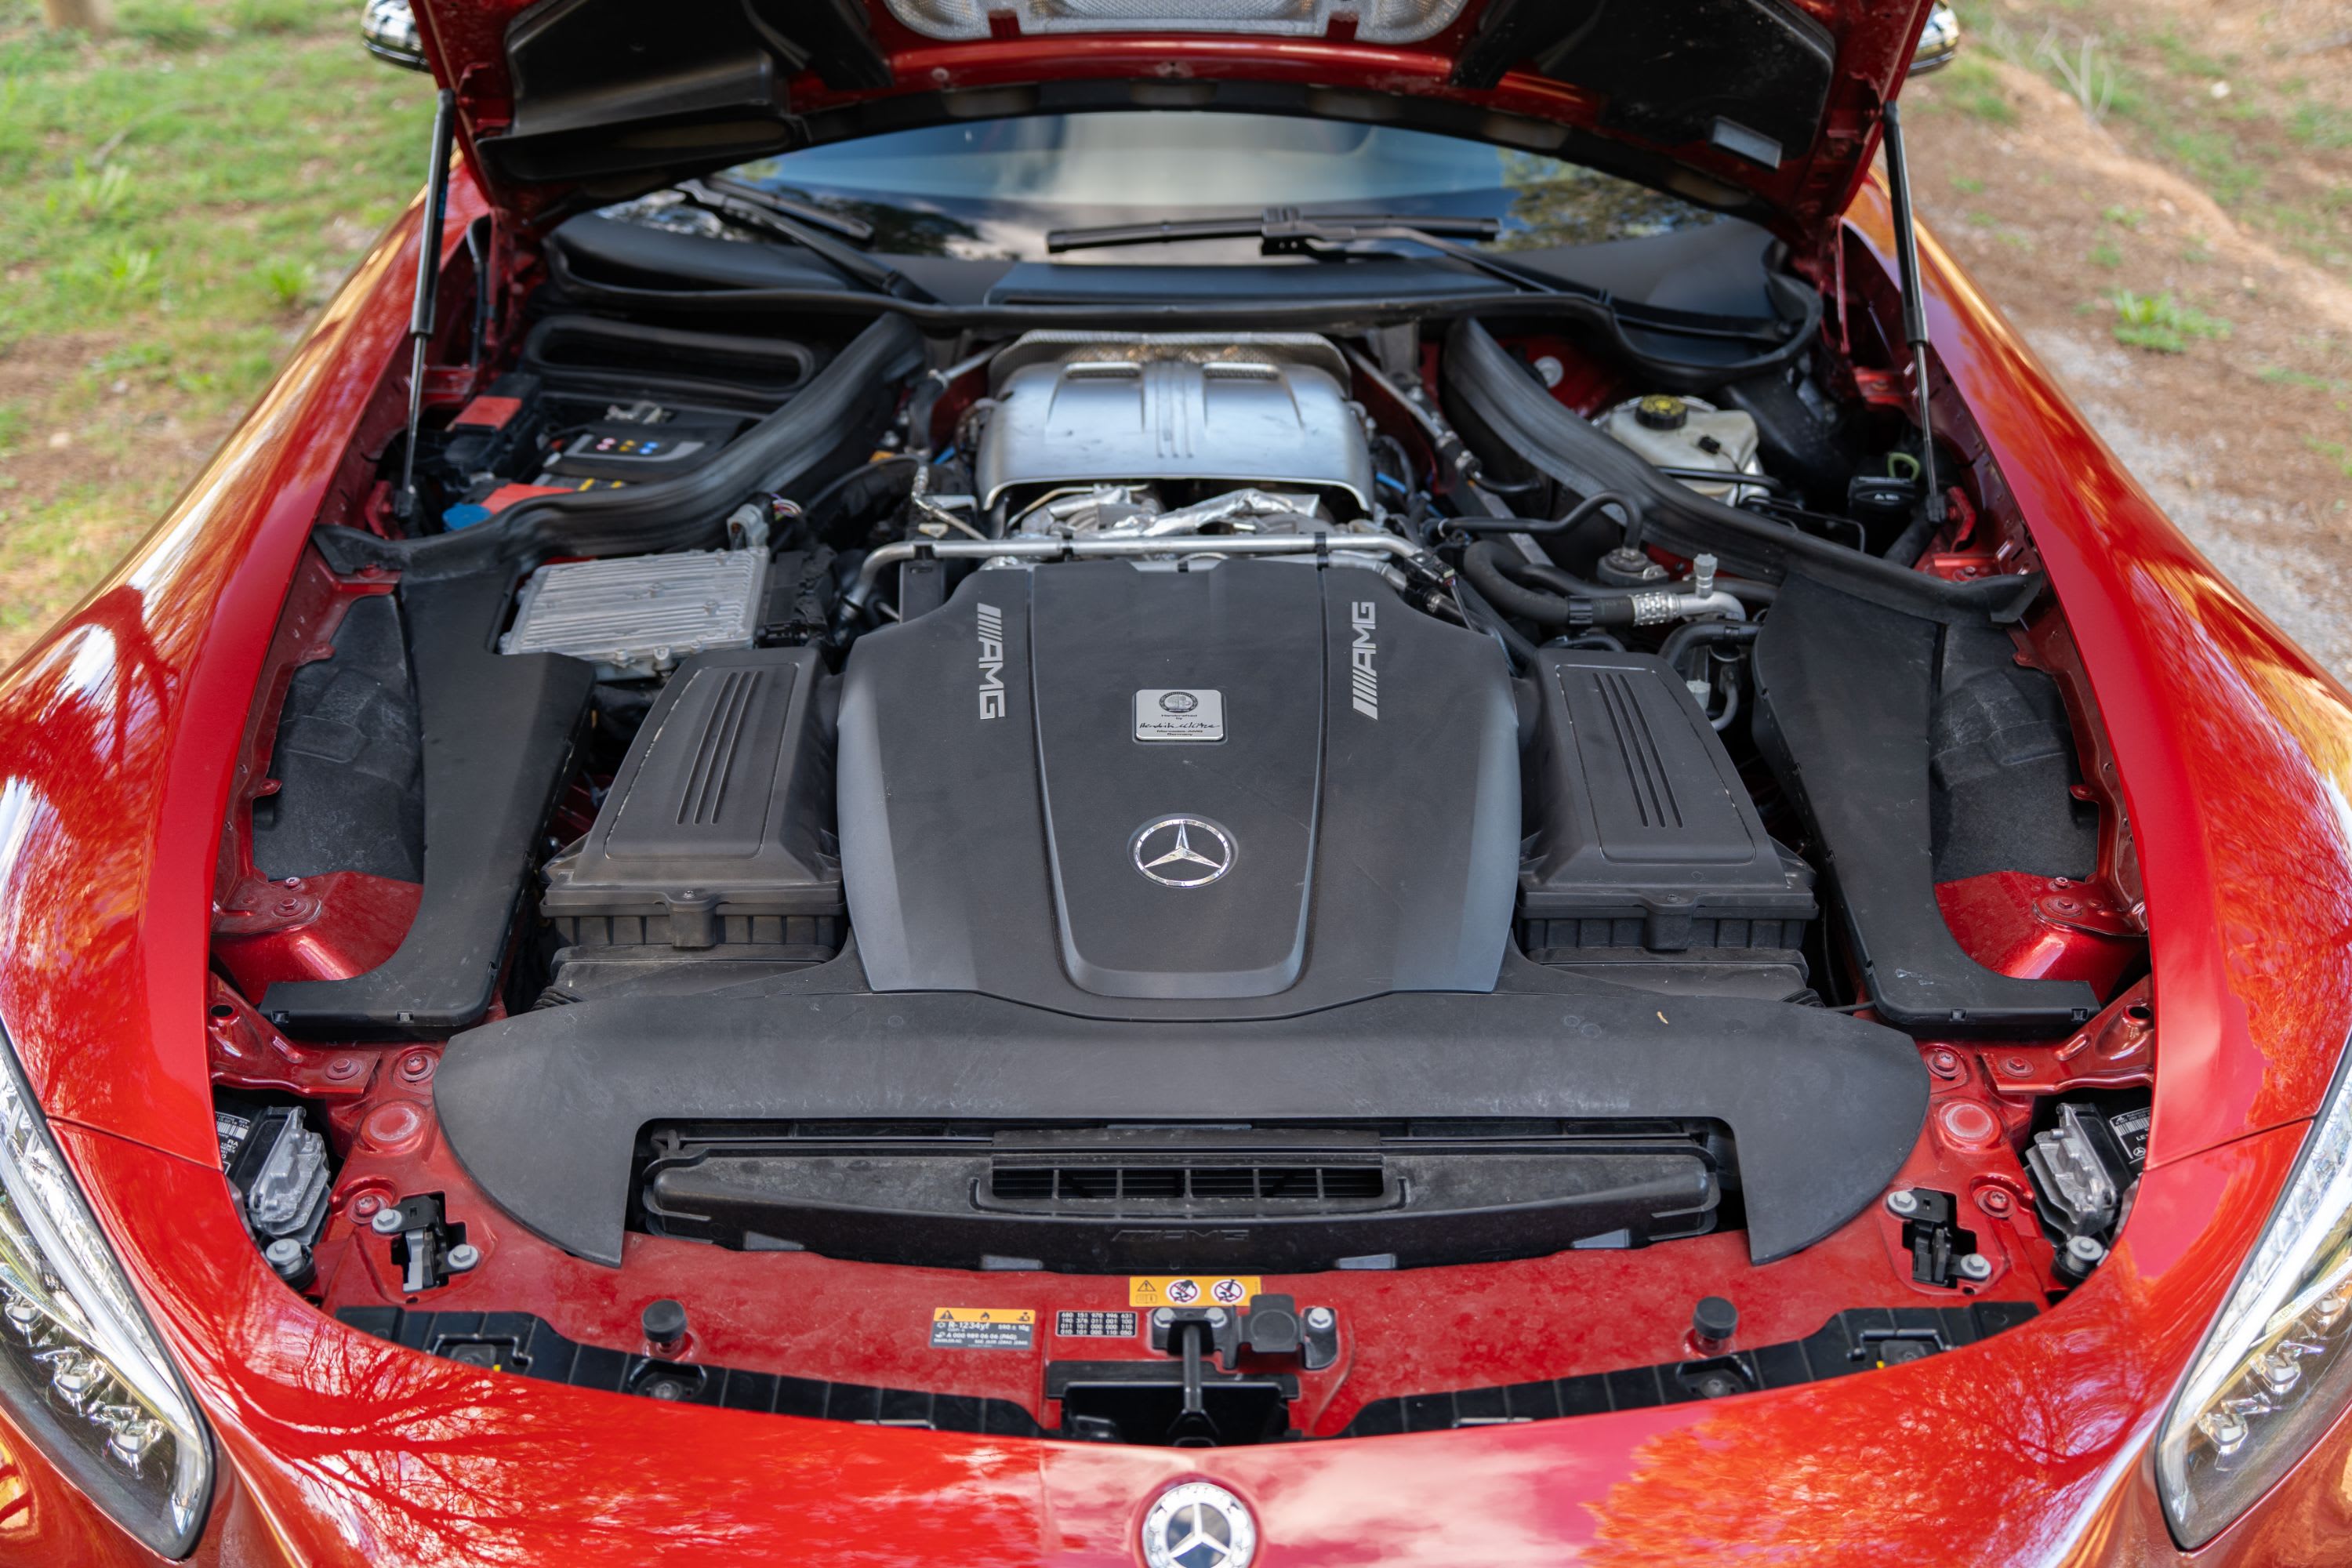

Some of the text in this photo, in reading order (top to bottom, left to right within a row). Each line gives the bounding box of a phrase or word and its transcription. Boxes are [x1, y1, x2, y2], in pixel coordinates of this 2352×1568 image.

[1352, 601, 1377, 675] AMG
[978, 638, 1006, 720] AMG
[948, 1321, 990, 1330] R-1234yf
